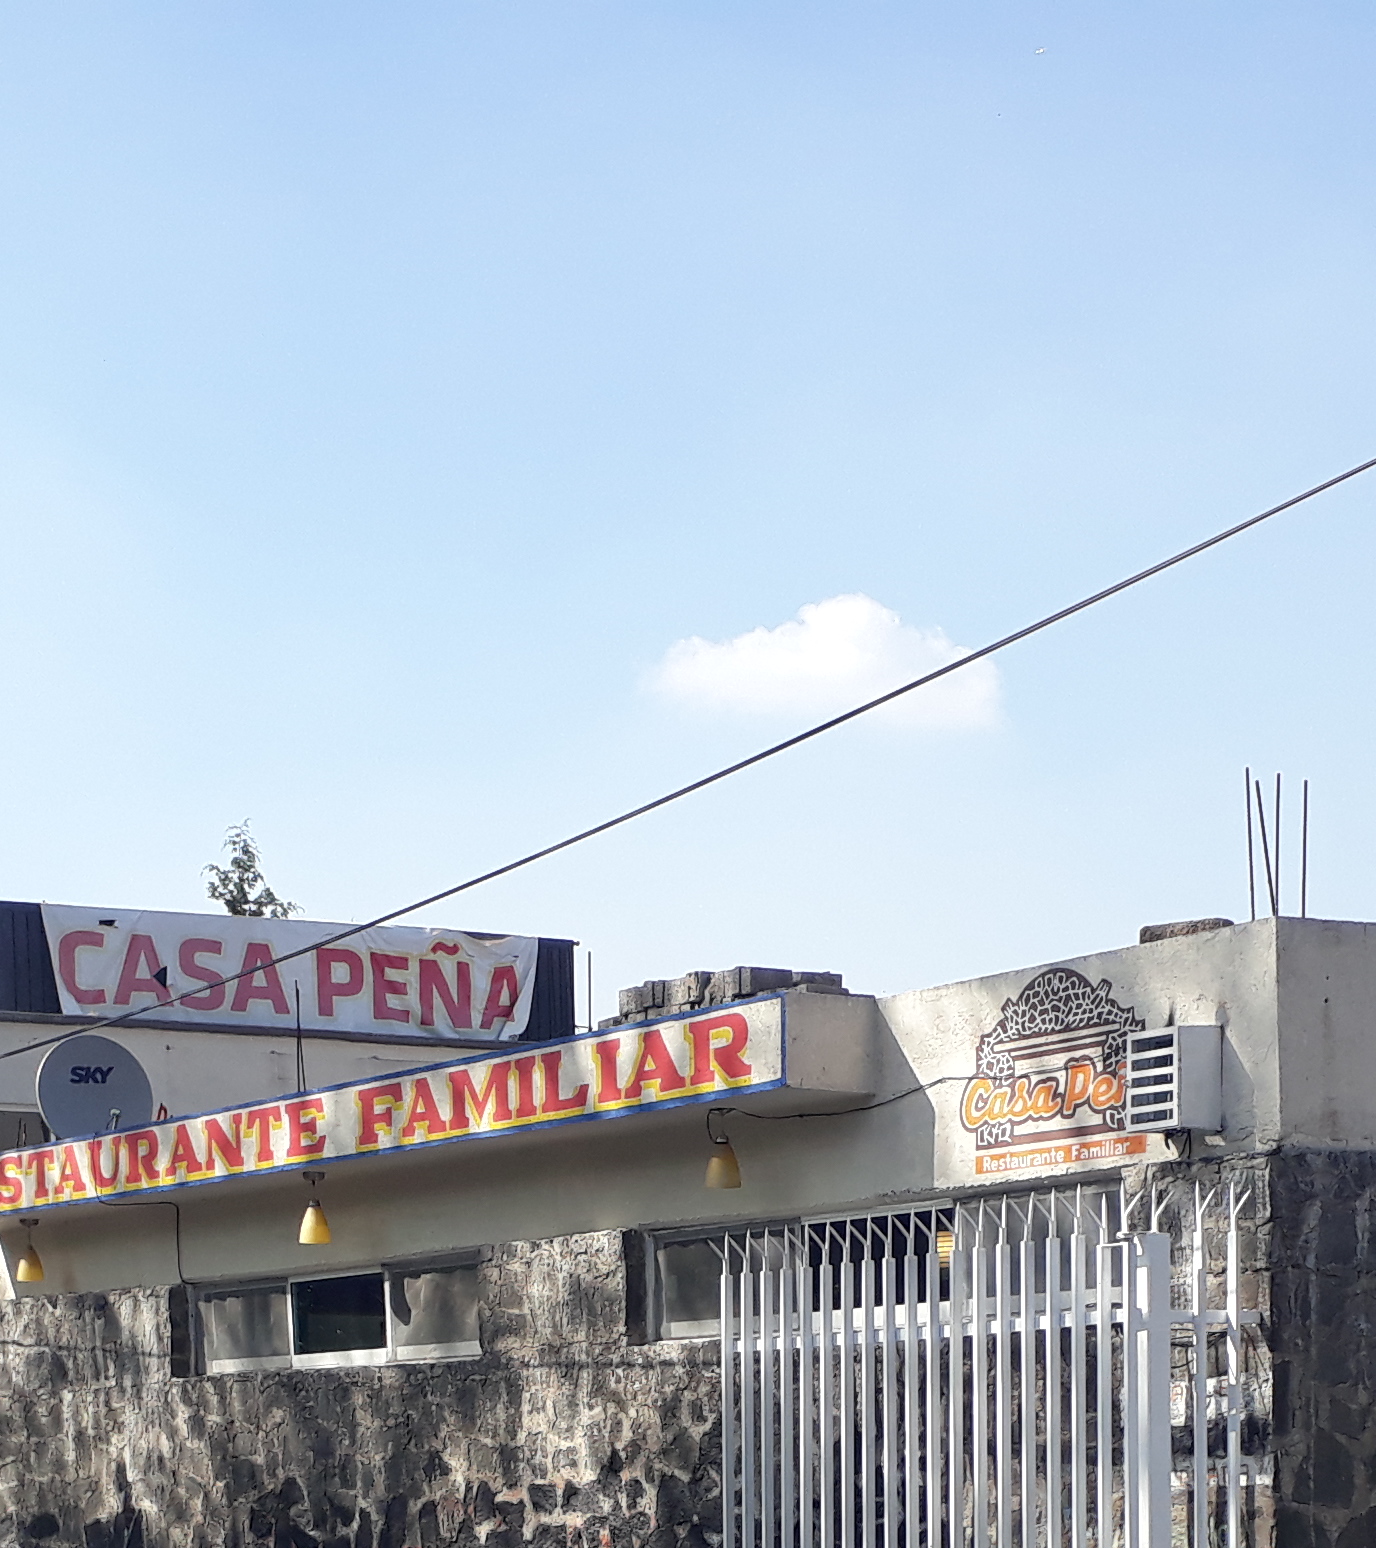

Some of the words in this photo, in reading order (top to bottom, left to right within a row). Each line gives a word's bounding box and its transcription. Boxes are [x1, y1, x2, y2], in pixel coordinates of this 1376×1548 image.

[58, 930, 289, 1014] CASA
[316, 942, 521, 1030] PEÑA
[70, 1066, 114, 1084] SKY
[356, 1014, 754, 1152] FAMILIAR
[964, 1077, 1062, 1127] Casa
[1063, 1061, 1126, 1114] Pe
[982, 1149, 1065, 1172] Restaurante
[1071, 1140, 1131, 1161] Familiar
